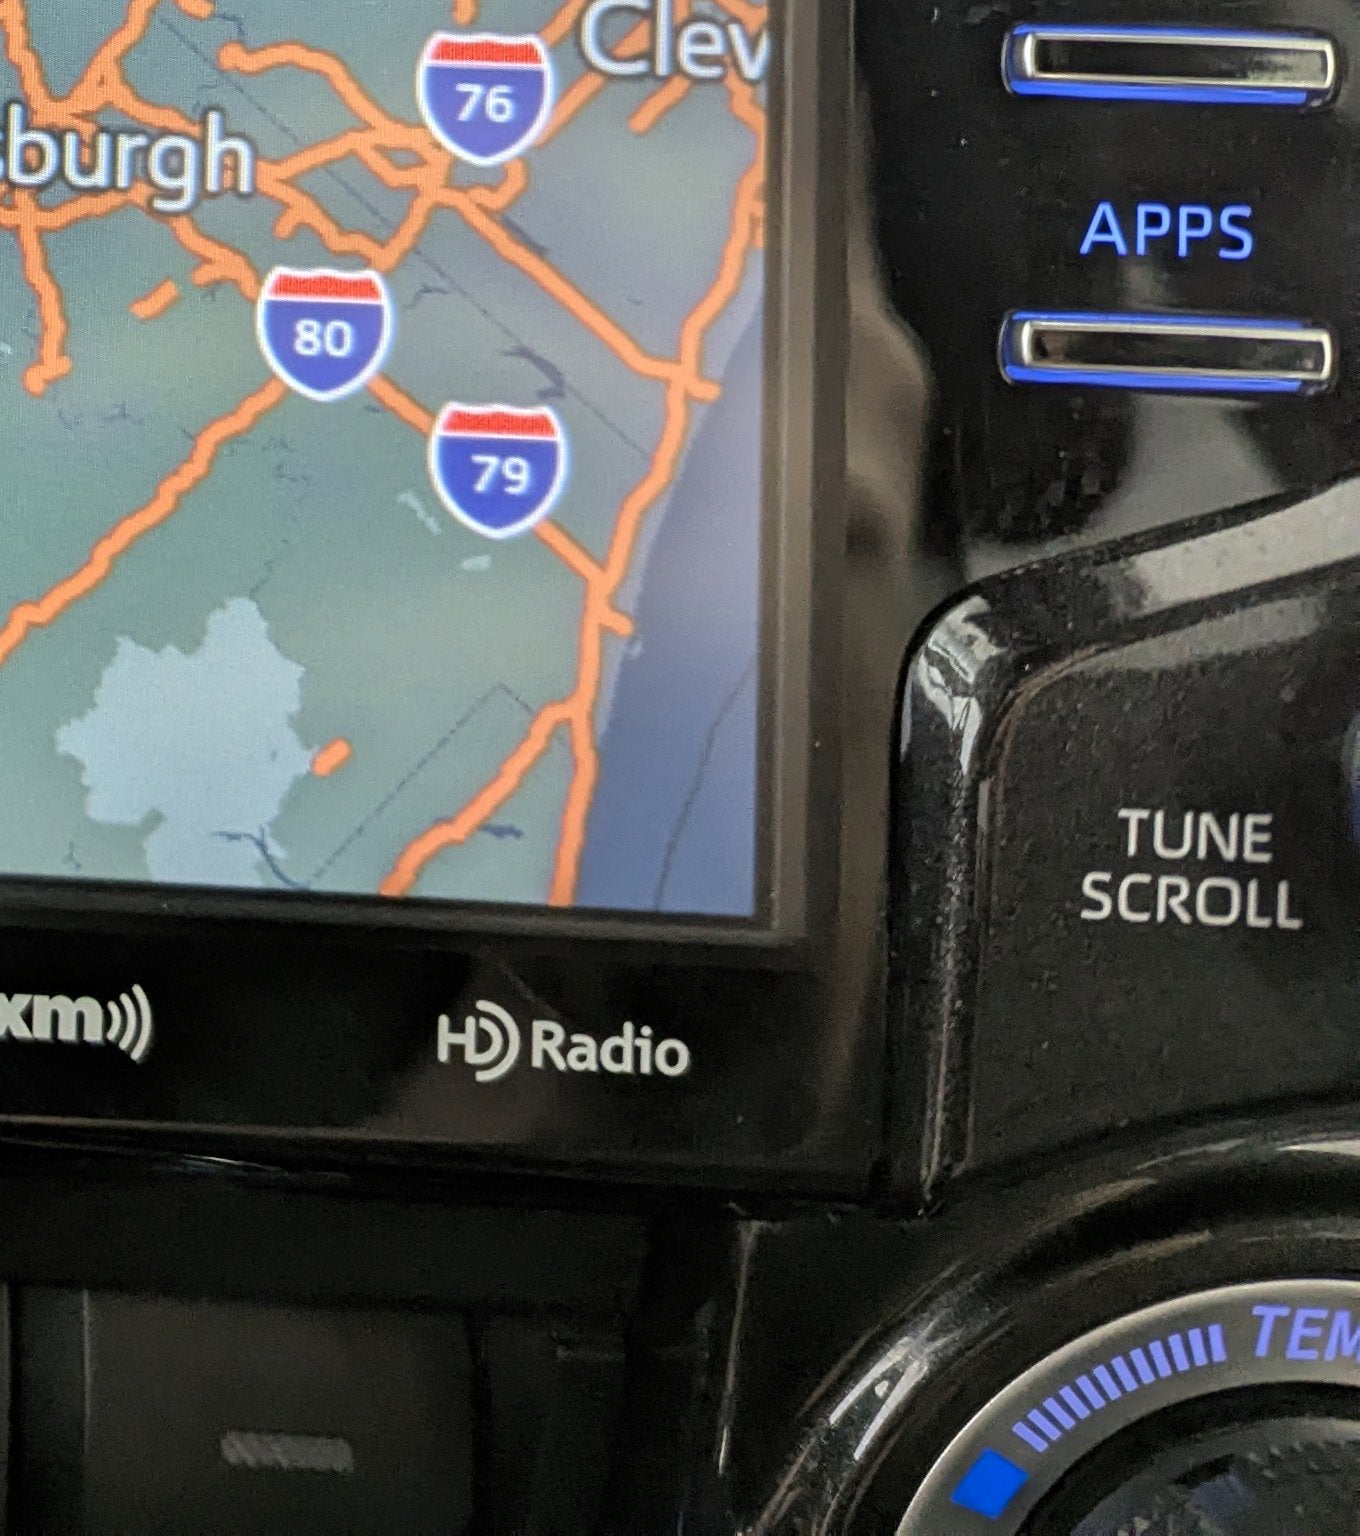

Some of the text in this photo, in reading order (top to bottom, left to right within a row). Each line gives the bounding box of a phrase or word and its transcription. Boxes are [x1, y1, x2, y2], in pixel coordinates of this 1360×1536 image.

[454, 82, 515, 125] 76
[1080, 201, 1254, 260] APPS
[293, 317, 353, 360] 80
[471, 453, 531, 498] 79
[1117, 808, 1273, 863] TUNE
[1080, 871, 1304, 930] SCROLL
[437, 1002, 691, 1078] HD Radio
